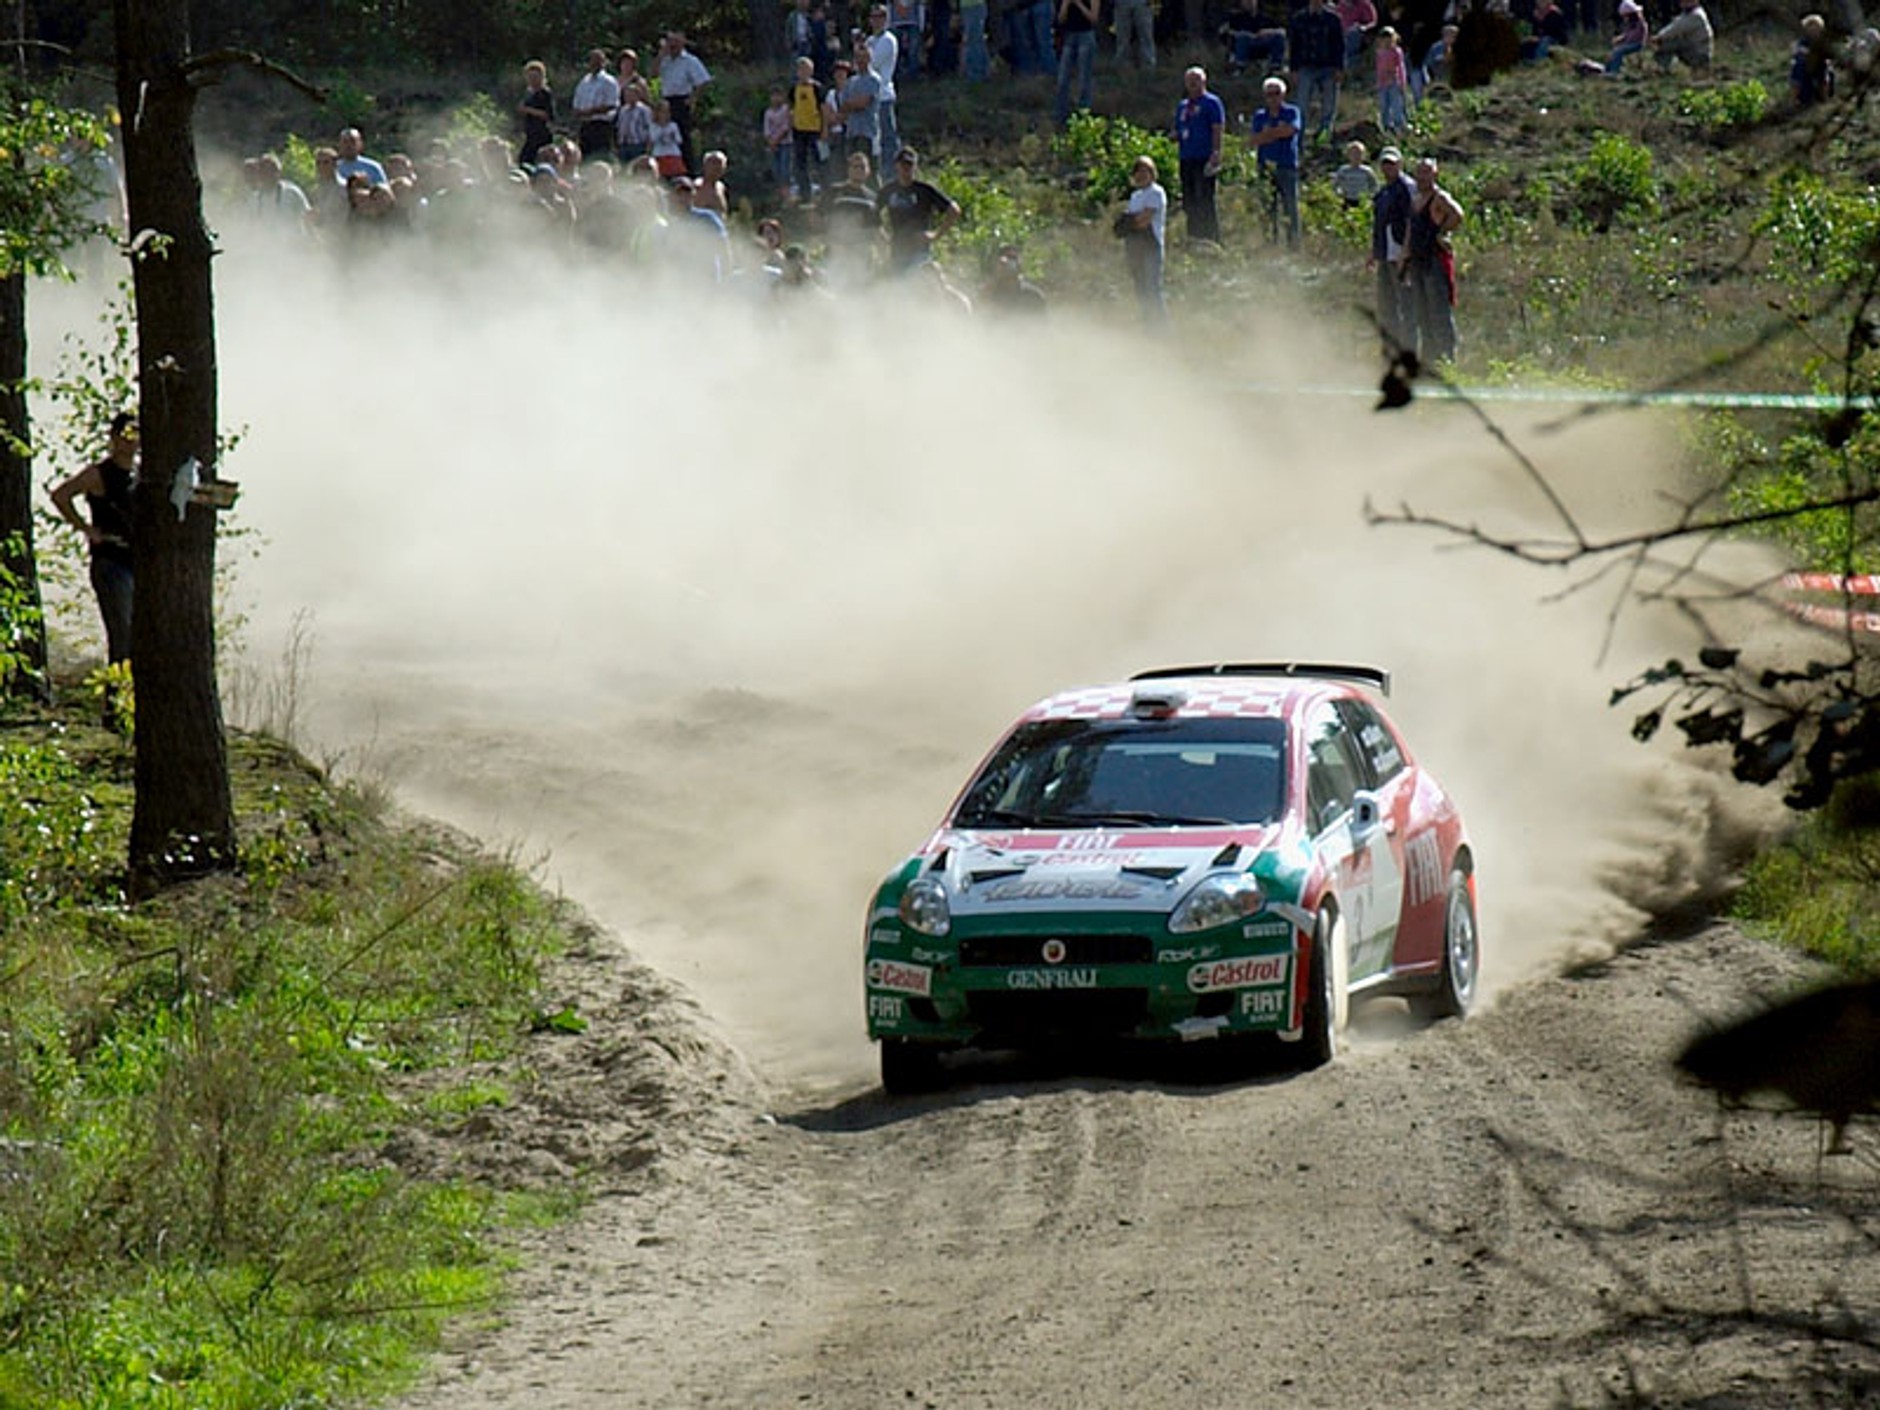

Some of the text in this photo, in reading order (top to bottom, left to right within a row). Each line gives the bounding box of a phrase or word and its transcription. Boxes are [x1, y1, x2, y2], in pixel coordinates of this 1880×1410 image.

[1055, 834, 1124, 850] FIAT
[1404, 827, 1445, 907] FIAT
[882, 964, 928, 992] Castrol
[1211, 958, 1281, 986] Castrol
[1241, 990, 1286, 1014] FIAT
